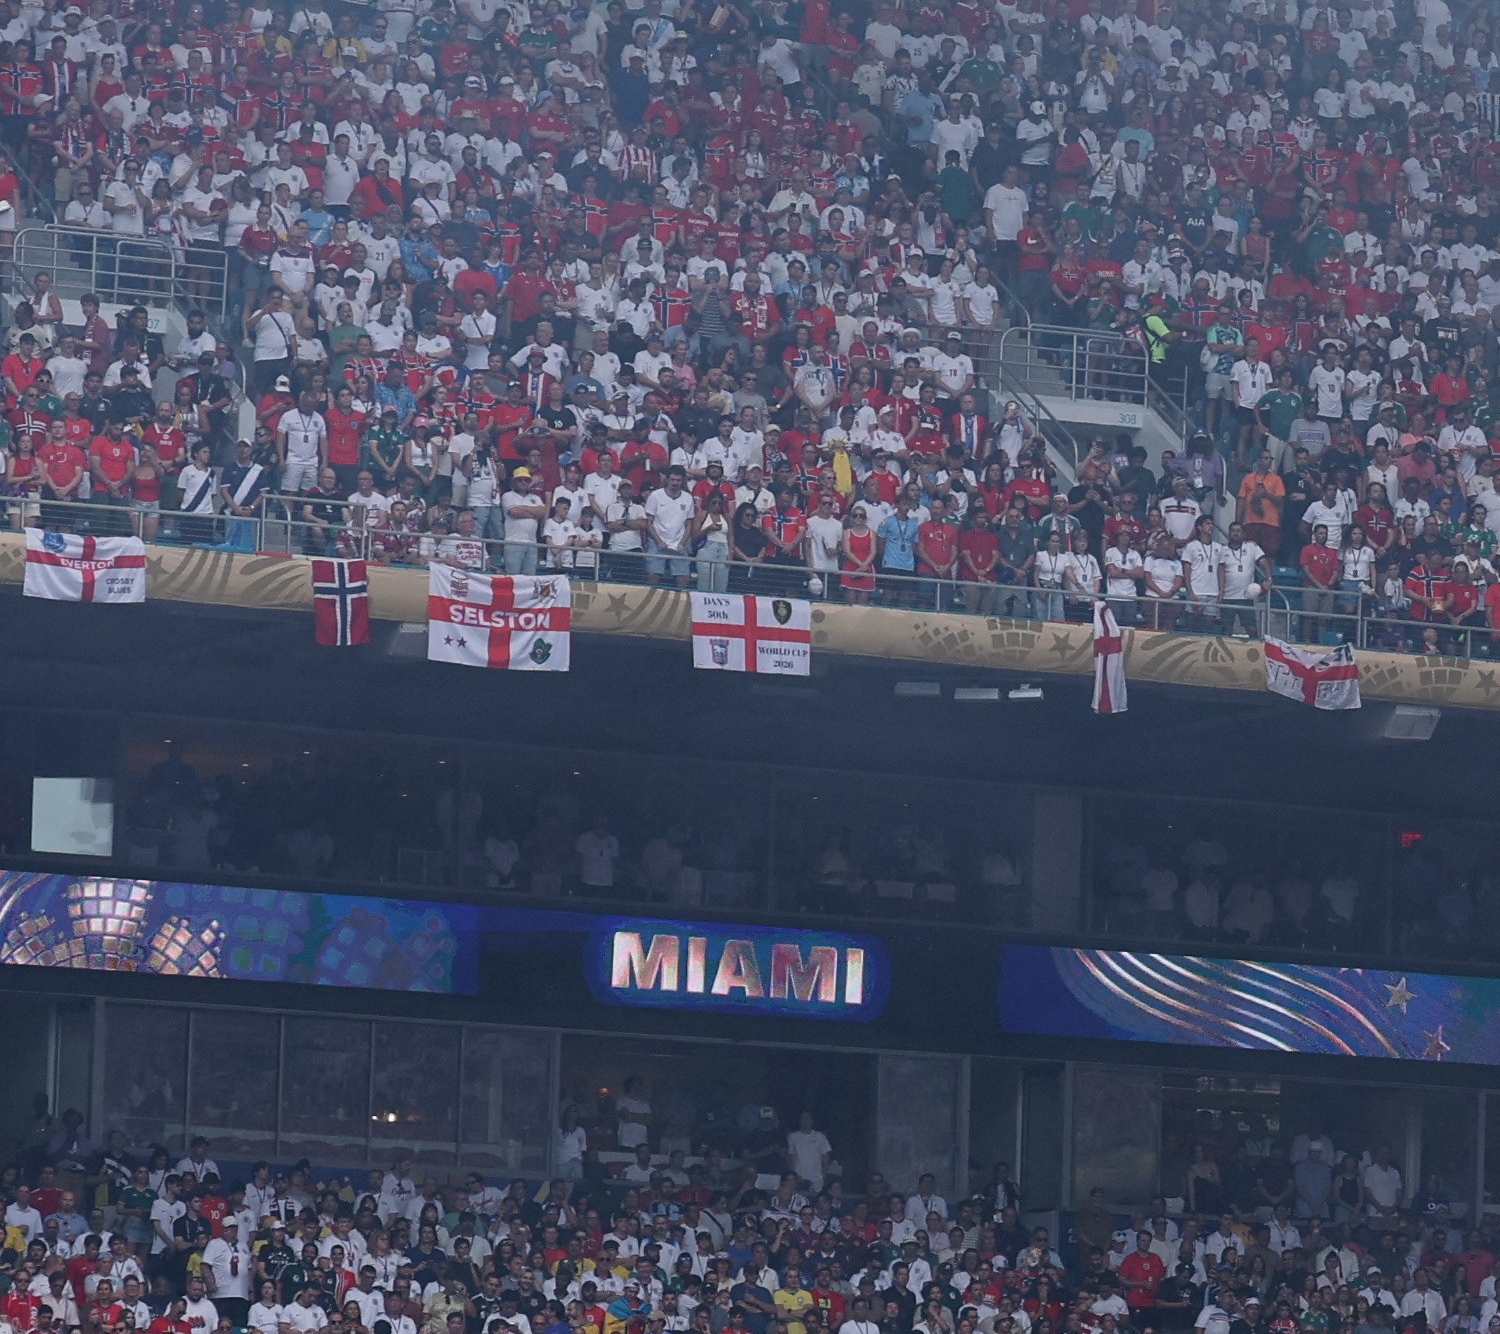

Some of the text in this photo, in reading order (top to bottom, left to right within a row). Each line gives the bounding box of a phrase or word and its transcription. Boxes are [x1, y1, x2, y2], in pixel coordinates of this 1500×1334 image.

[60, 557, 115, 571] EVERTON
[703, 596, 731, 606] DAN'S
[449, 604, 551, 630] SELSTON
[758, 646, 809, 658] WORLD CUP
[611, 930, 865, 1005] MIAMI
